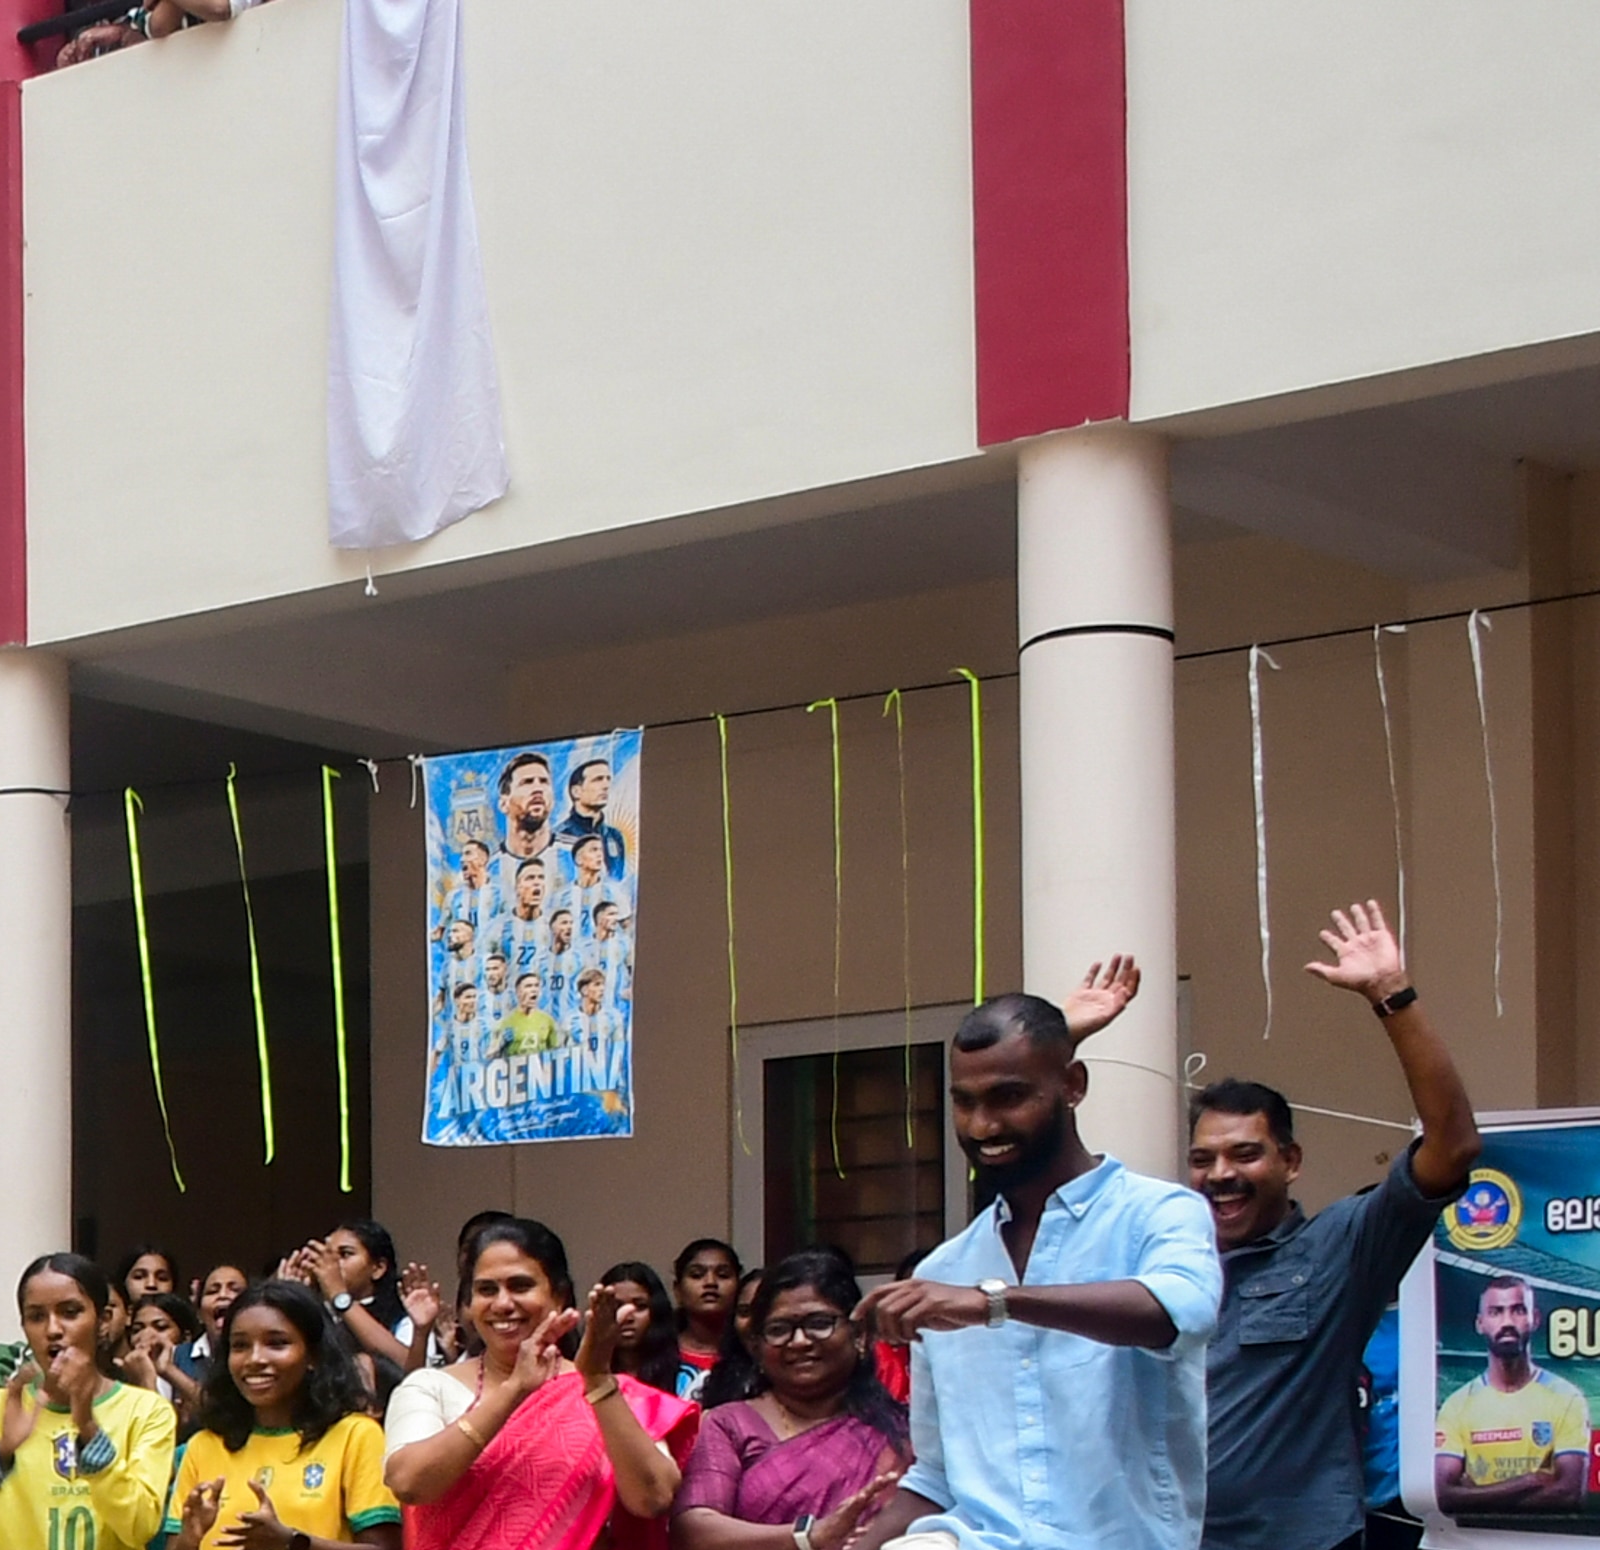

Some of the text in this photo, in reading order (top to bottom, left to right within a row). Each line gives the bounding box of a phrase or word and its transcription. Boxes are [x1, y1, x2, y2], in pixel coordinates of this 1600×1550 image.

[437, 1040, 626, 1119] ARGENTINA
[1472, 1429, 1522, 1443] FREEMANS
[1495, 1456, 1540, 1468] WHITE
[50, 1485, 92, 1497] BRASIL
